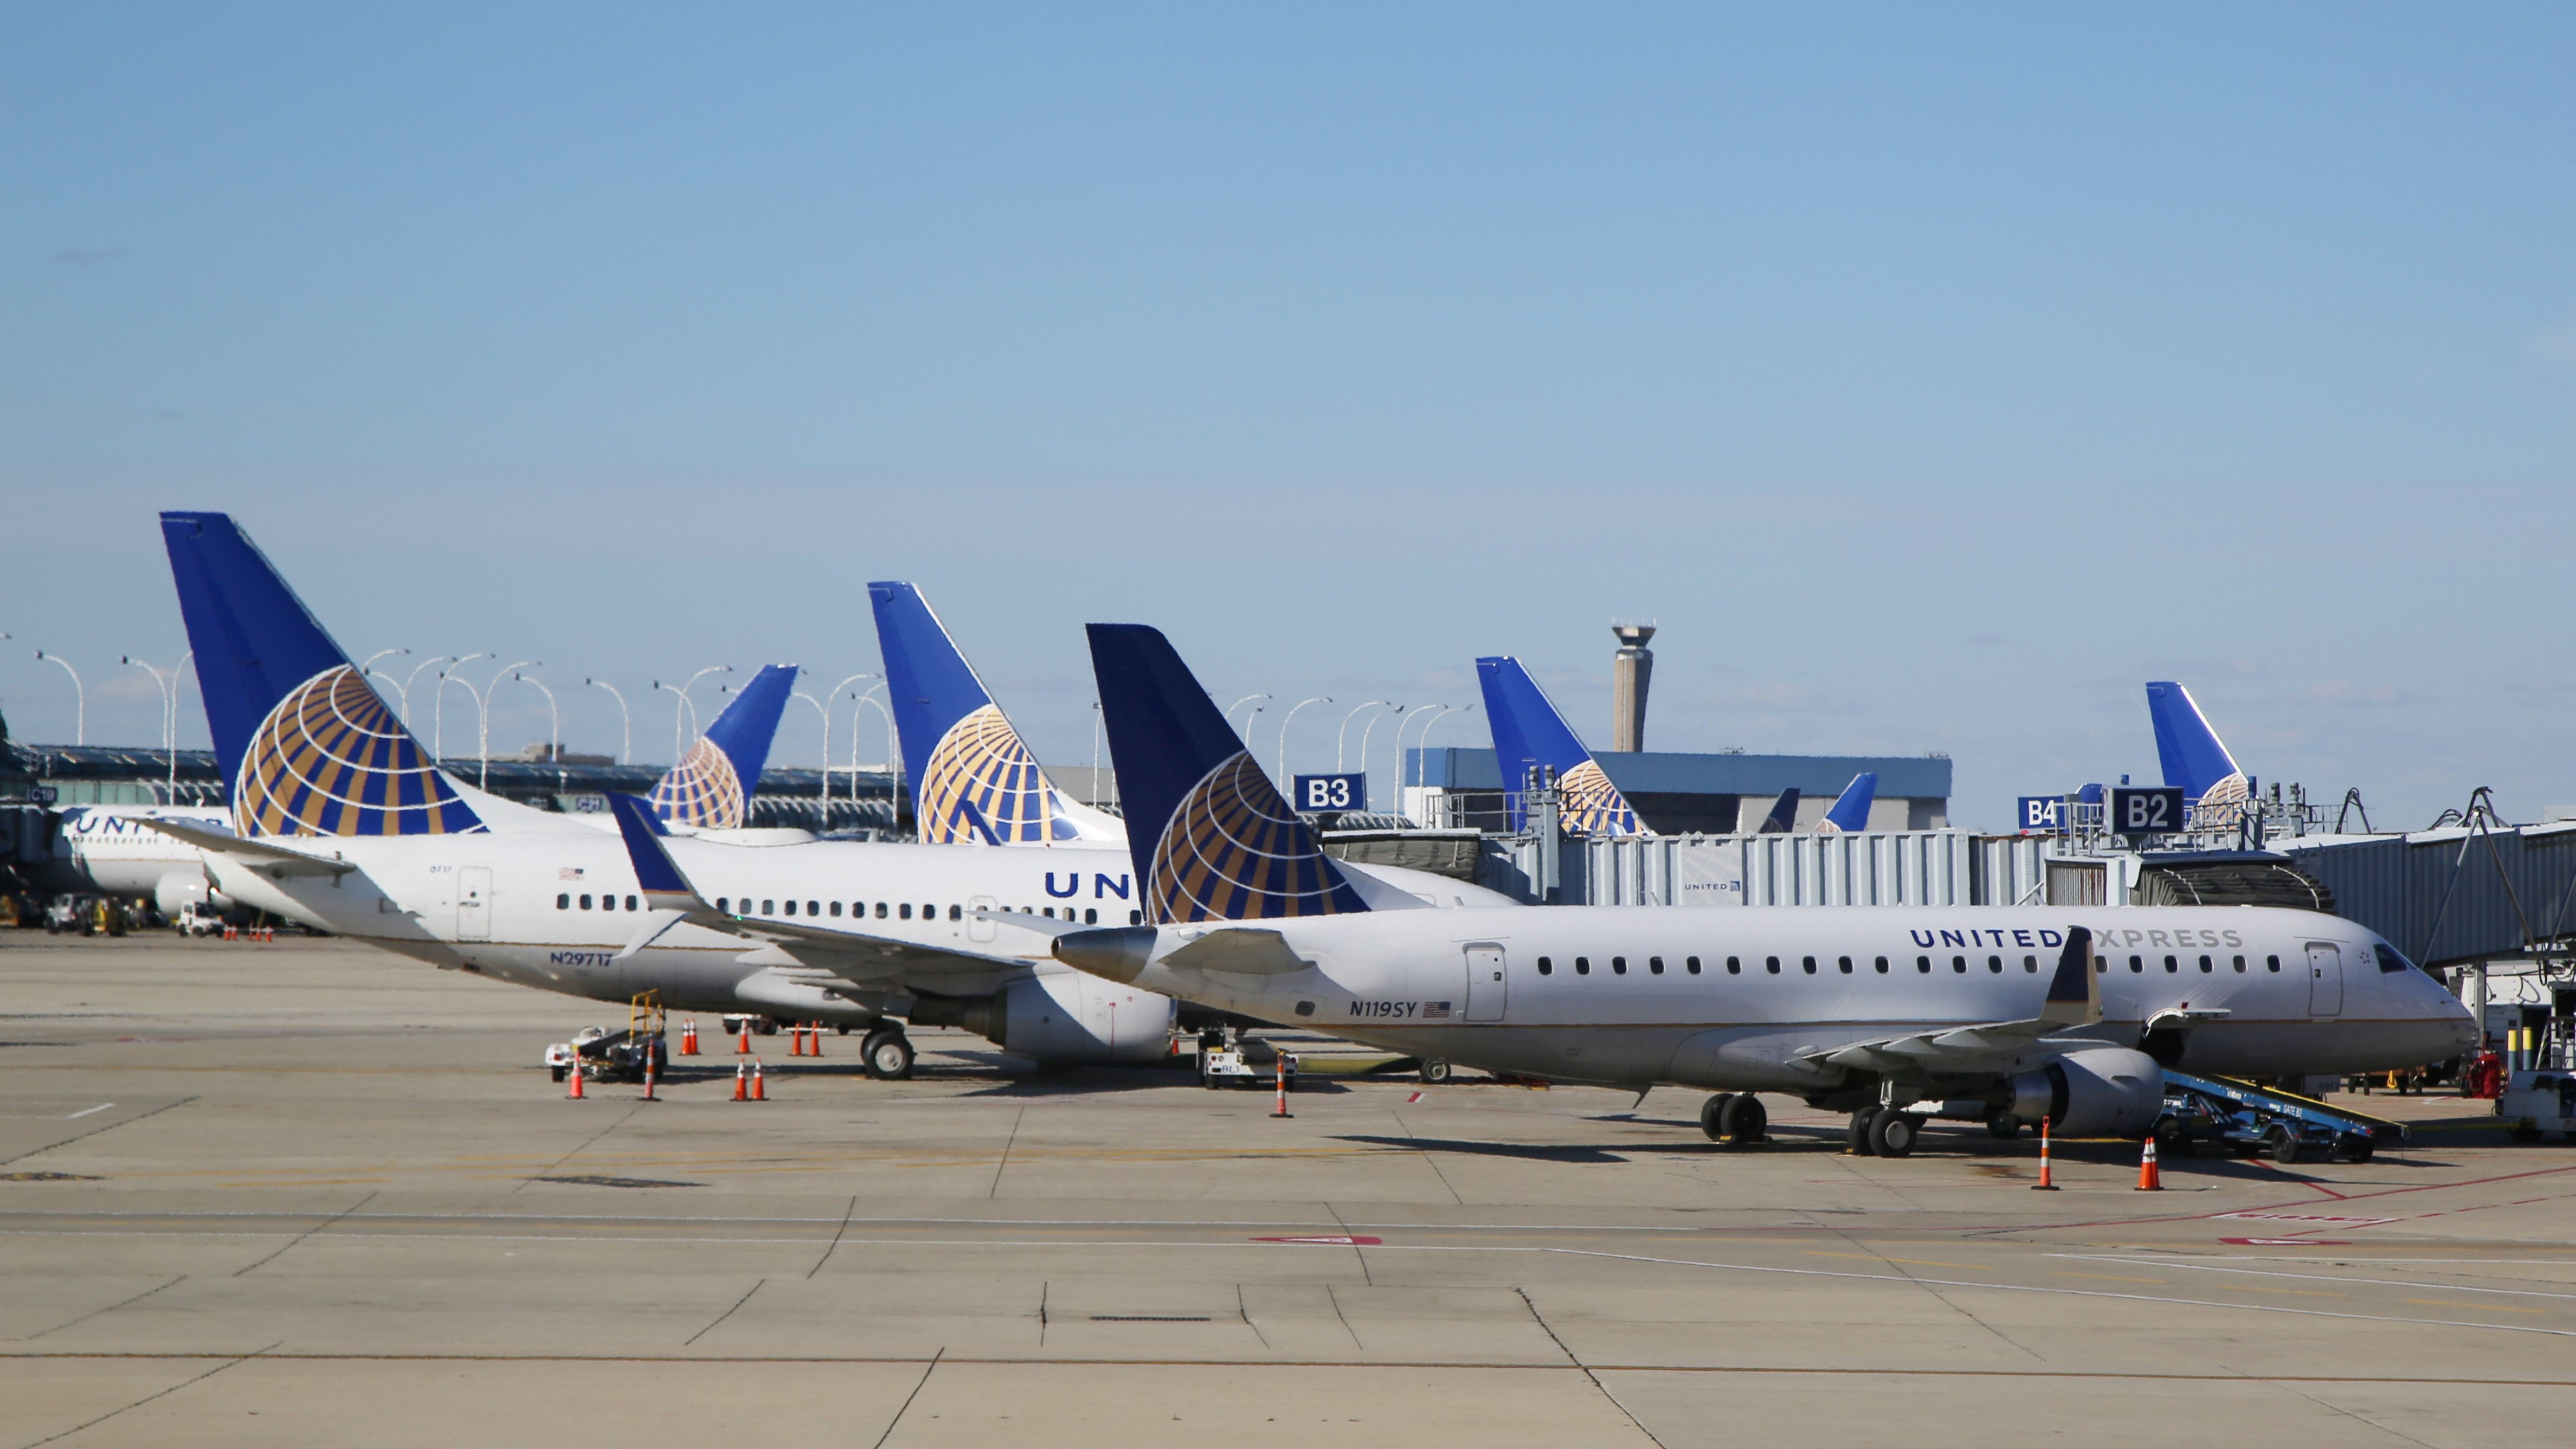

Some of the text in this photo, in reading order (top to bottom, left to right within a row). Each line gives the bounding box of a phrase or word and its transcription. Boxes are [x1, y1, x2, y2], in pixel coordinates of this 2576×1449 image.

[31, 789, 55, 801] C19
[1309, 778, 1350, 808] B3
[2028, 800, 2056, 825] B4
[2129, 794, 2168, 827] B2
[1045, 872, 1129, 900] UN
[1910, 929, 2243, 948] UNITED XPRESS
[550, 952, 613, 967] N29717
[1350, 1001, 1418, 1017] N119SY
[2283, 1104, 2296, 1116] GATE
[2296, 1106, 2303, 1118] B2
